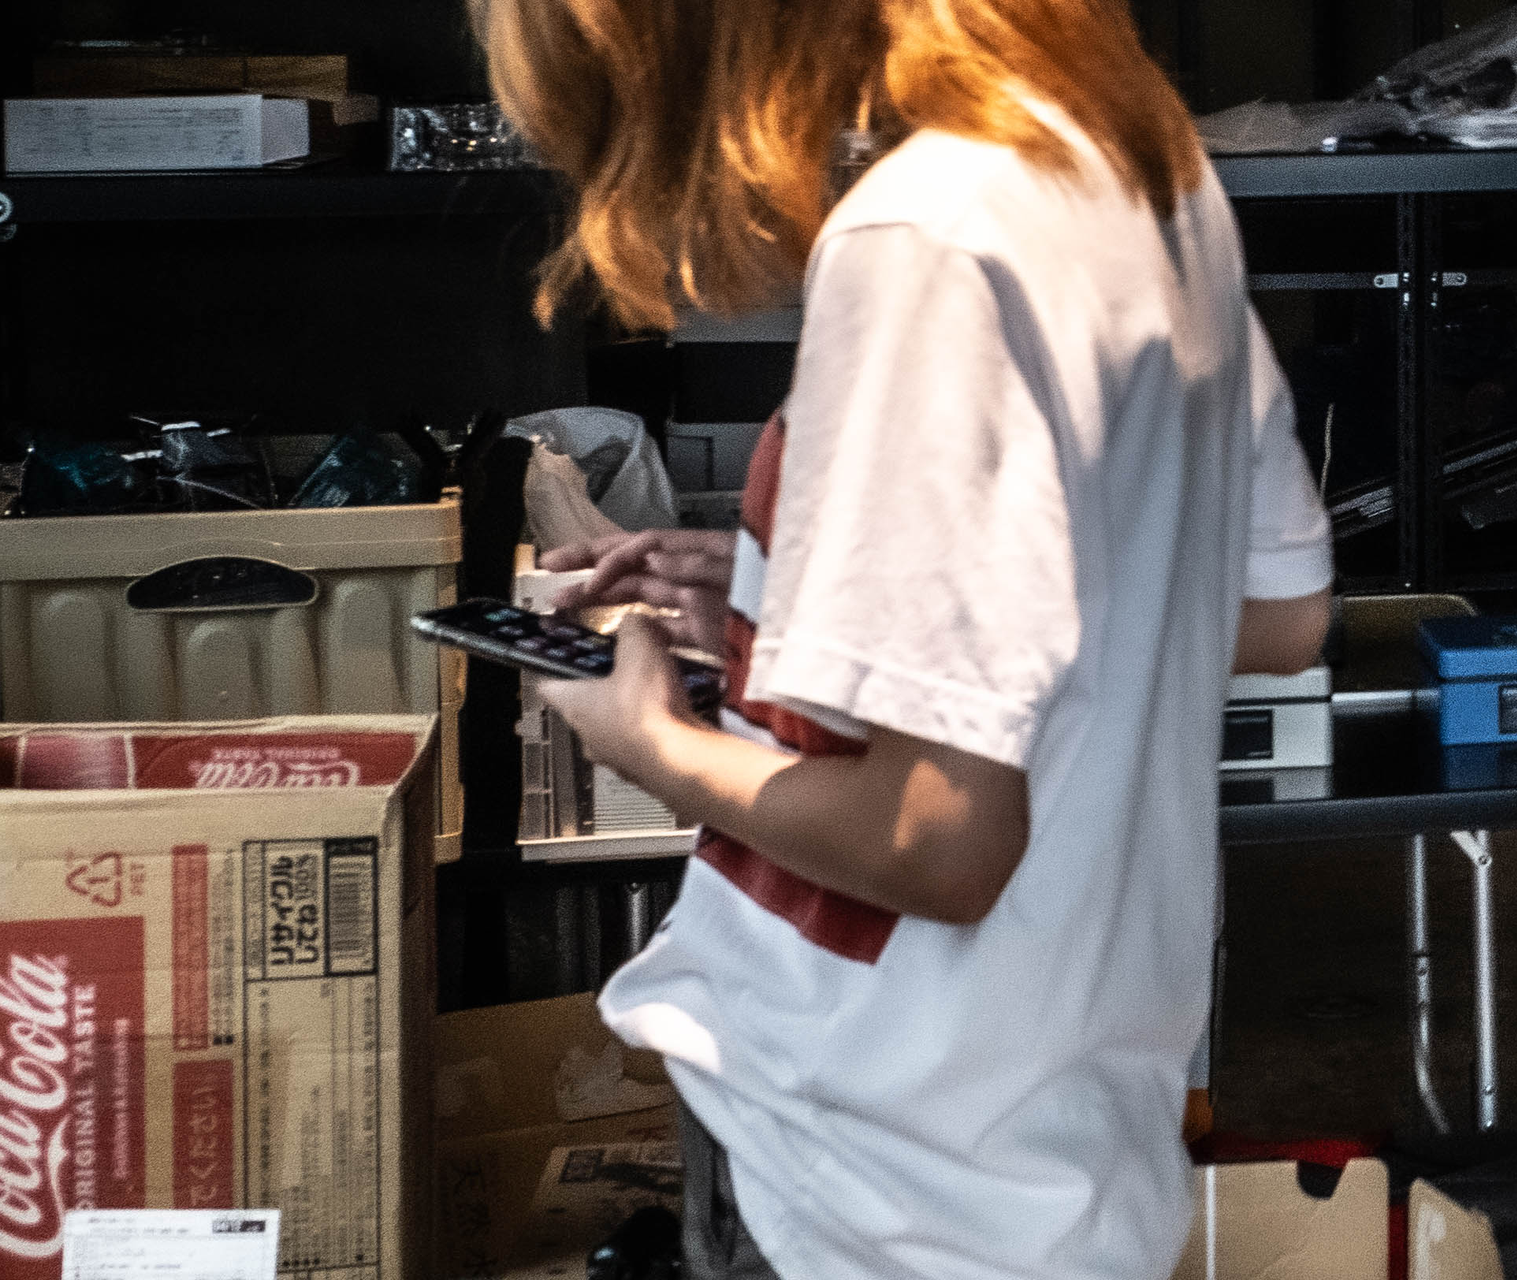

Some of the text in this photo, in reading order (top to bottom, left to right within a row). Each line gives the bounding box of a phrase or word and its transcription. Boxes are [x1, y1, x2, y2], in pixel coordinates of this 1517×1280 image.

[270, 855, 294, 965] リサイクル
[295, 903, 320, 964] してね
[73, 984, 96, 1209] ORIGINAL TASTE
